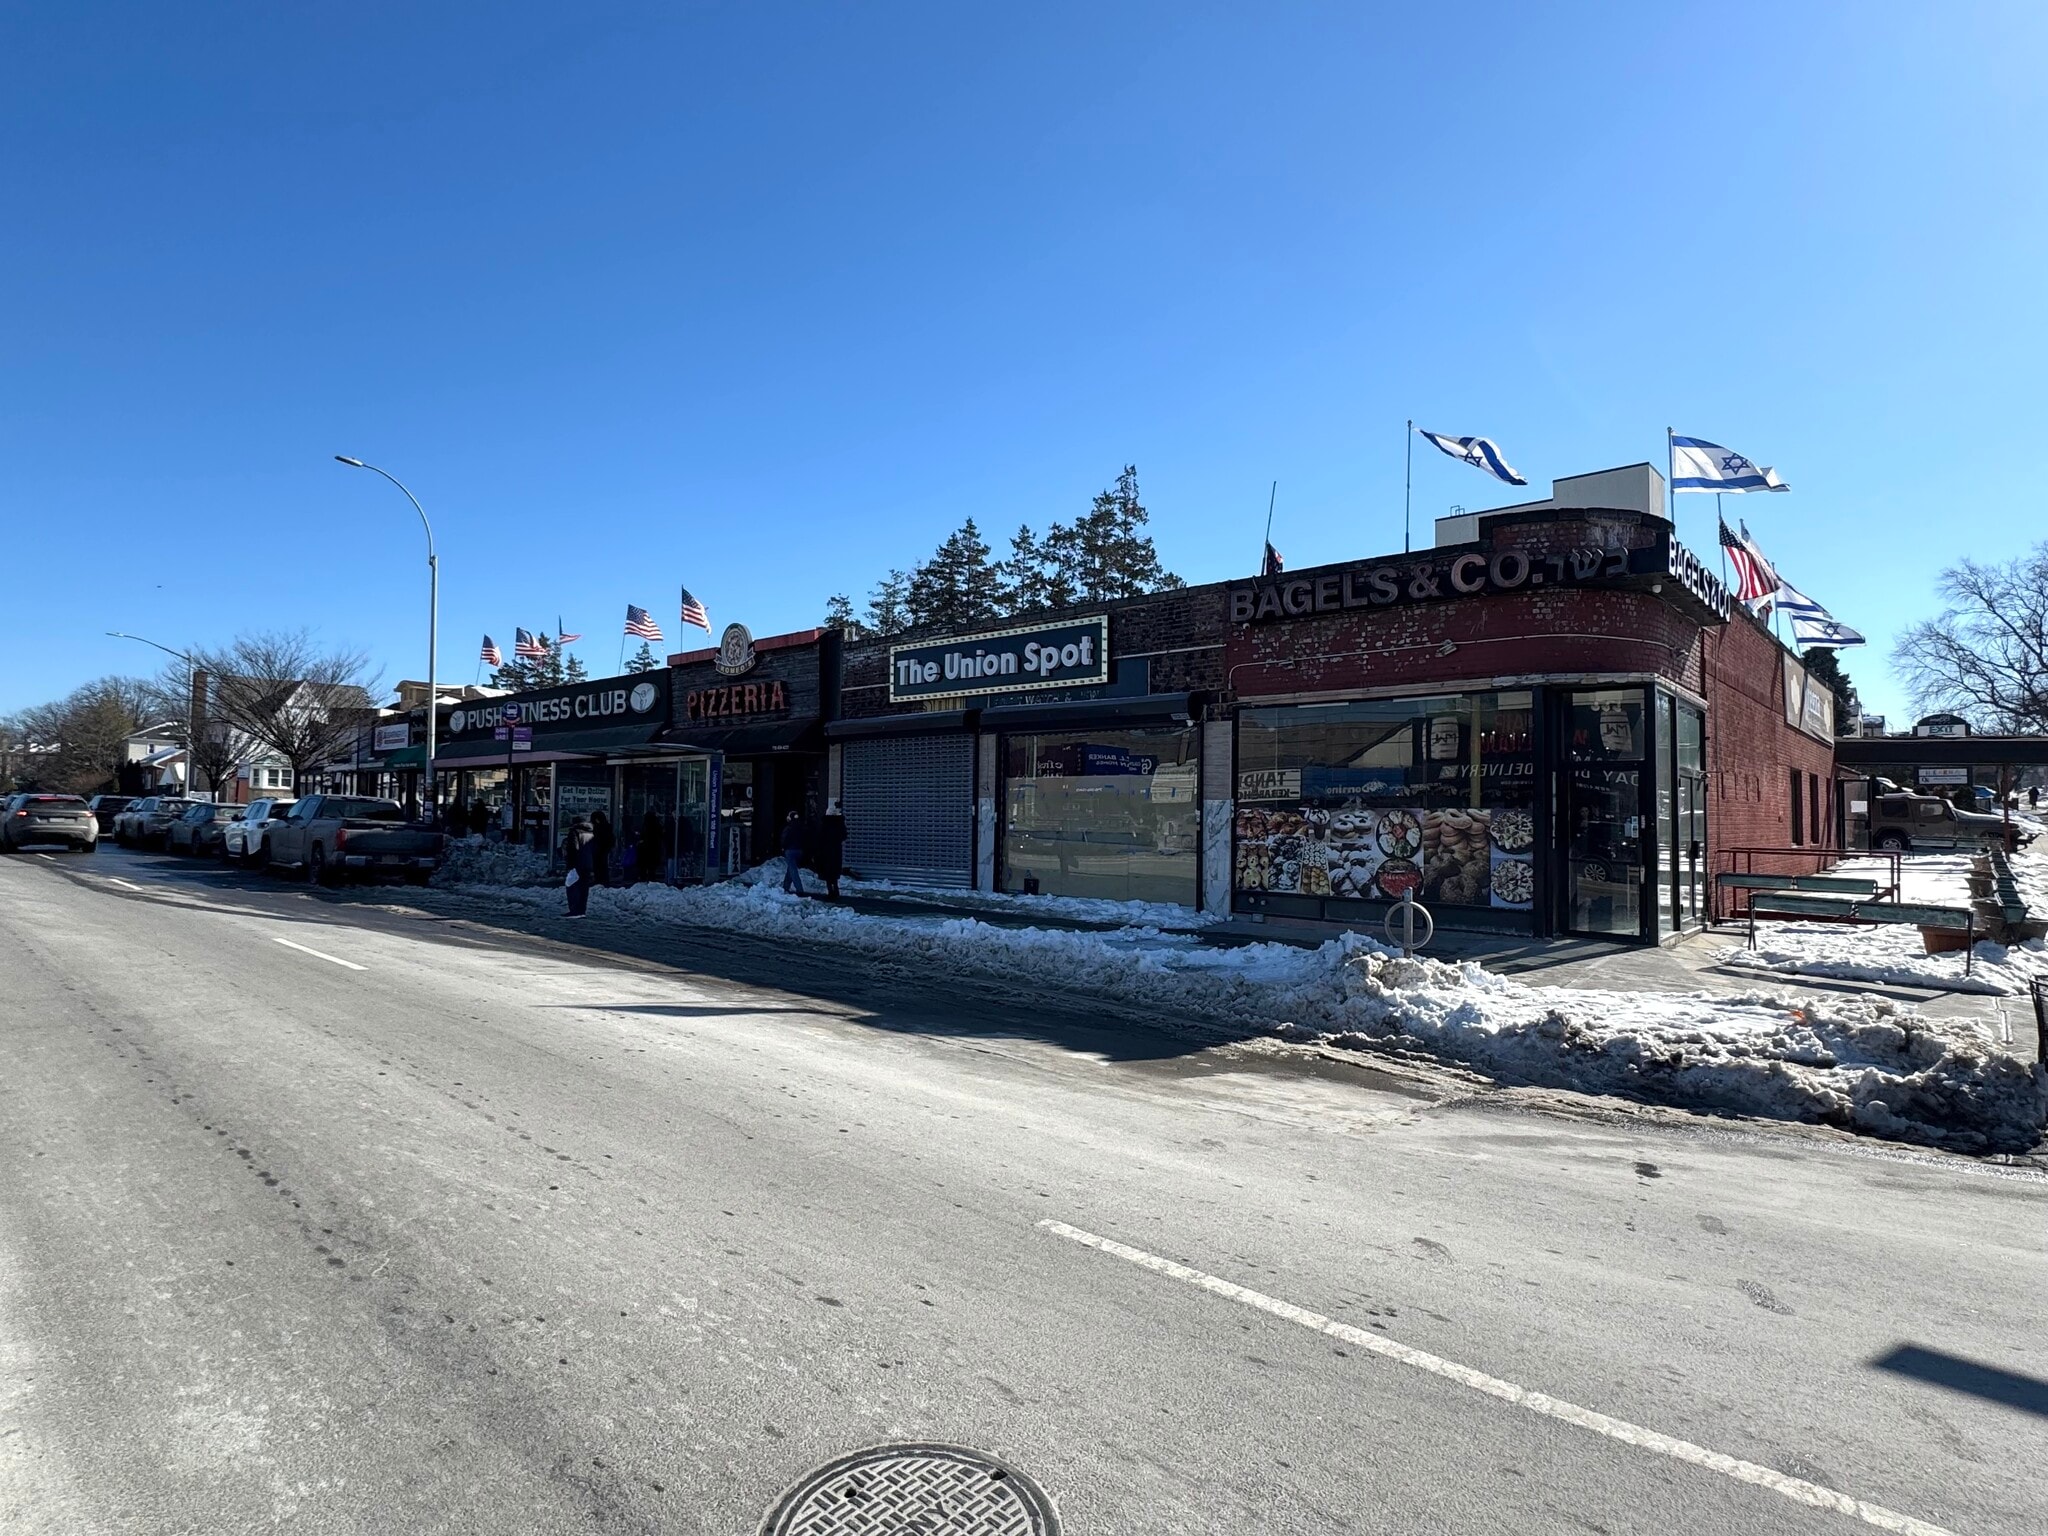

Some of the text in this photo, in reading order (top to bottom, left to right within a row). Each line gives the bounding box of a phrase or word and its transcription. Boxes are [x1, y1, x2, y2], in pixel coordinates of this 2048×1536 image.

[1230, 549, 1545, 622] BAGELS & CO.
[896, 635, 1094, 686] The Union Spot
[467, 689, 627, 730] PUSH TNESS CLUB
[686, 680, 788, 721] PIZZERIA
[1929, 725, 1954, 734] EXIT
